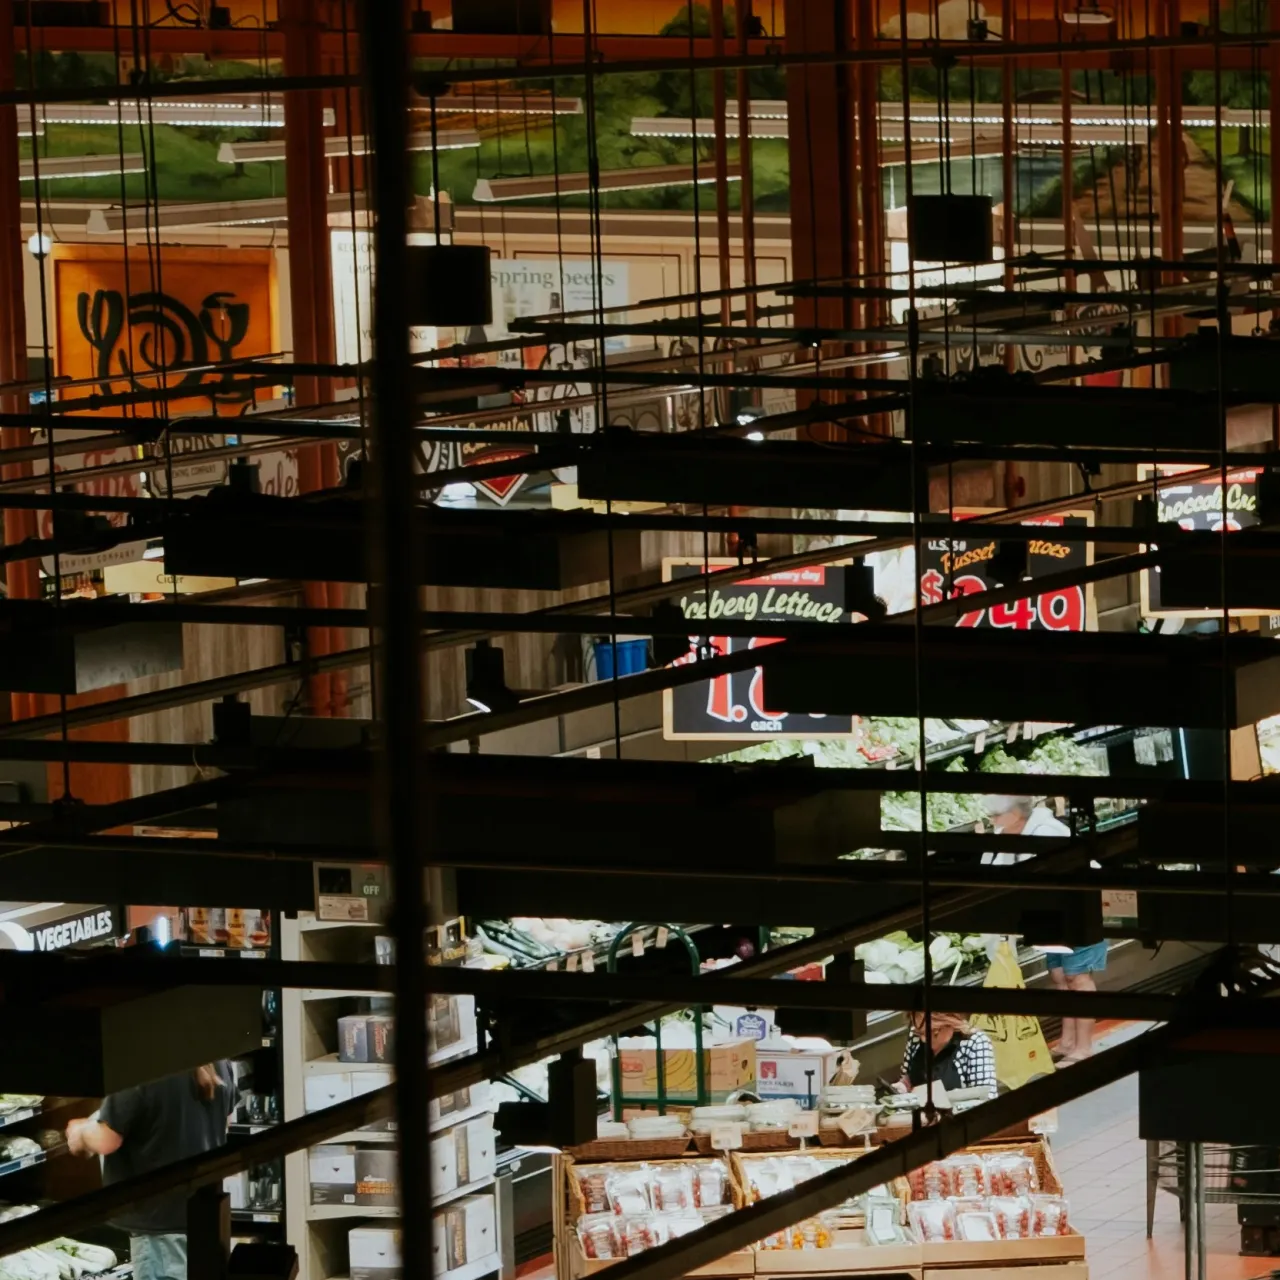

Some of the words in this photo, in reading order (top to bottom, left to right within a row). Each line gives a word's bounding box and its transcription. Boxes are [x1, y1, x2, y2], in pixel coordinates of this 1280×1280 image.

[155, 573, 184, 585] Cider
[761, 587, 844, 623] Lettuce
[750, 719, 783, 732] each
[362, 884, 381, 895] OFF
[36, 910, 113, 952] VEGETABLES
